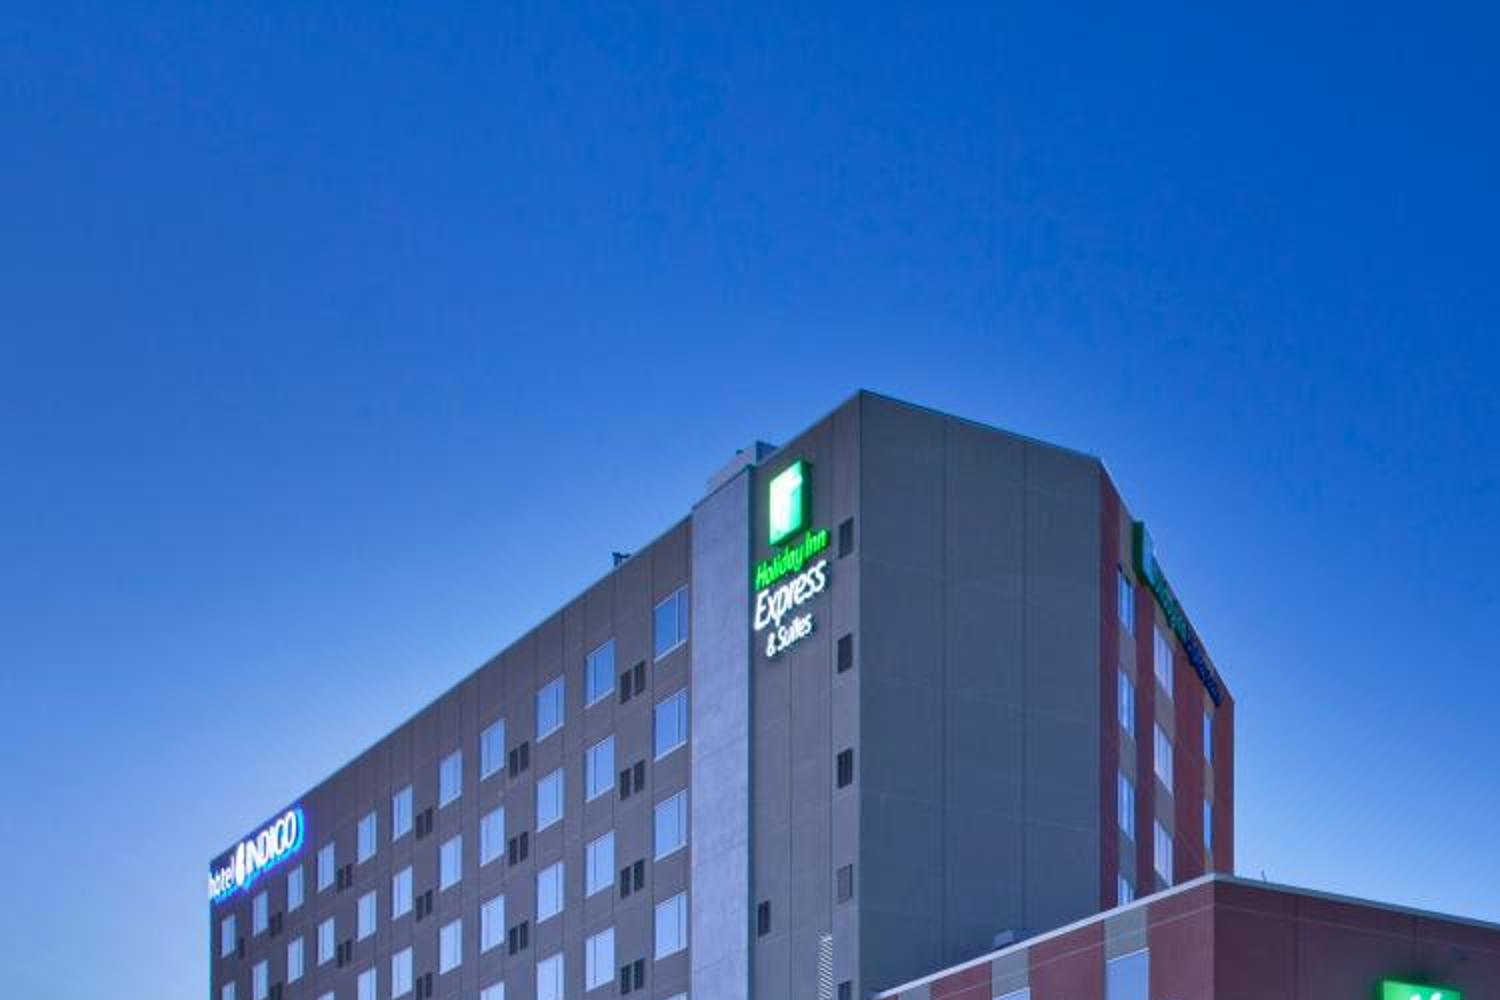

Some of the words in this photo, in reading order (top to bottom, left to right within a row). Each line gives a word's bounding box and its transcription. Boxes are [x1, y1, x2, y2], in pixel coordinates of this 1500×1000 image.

[755, 546, 803, 590] Holiday
[805, 528, 830, 557] Inn
[754, 560, 826, 631] Express
[766, 632, 776, 657] &
[777, 614, 812, 651] Suites
